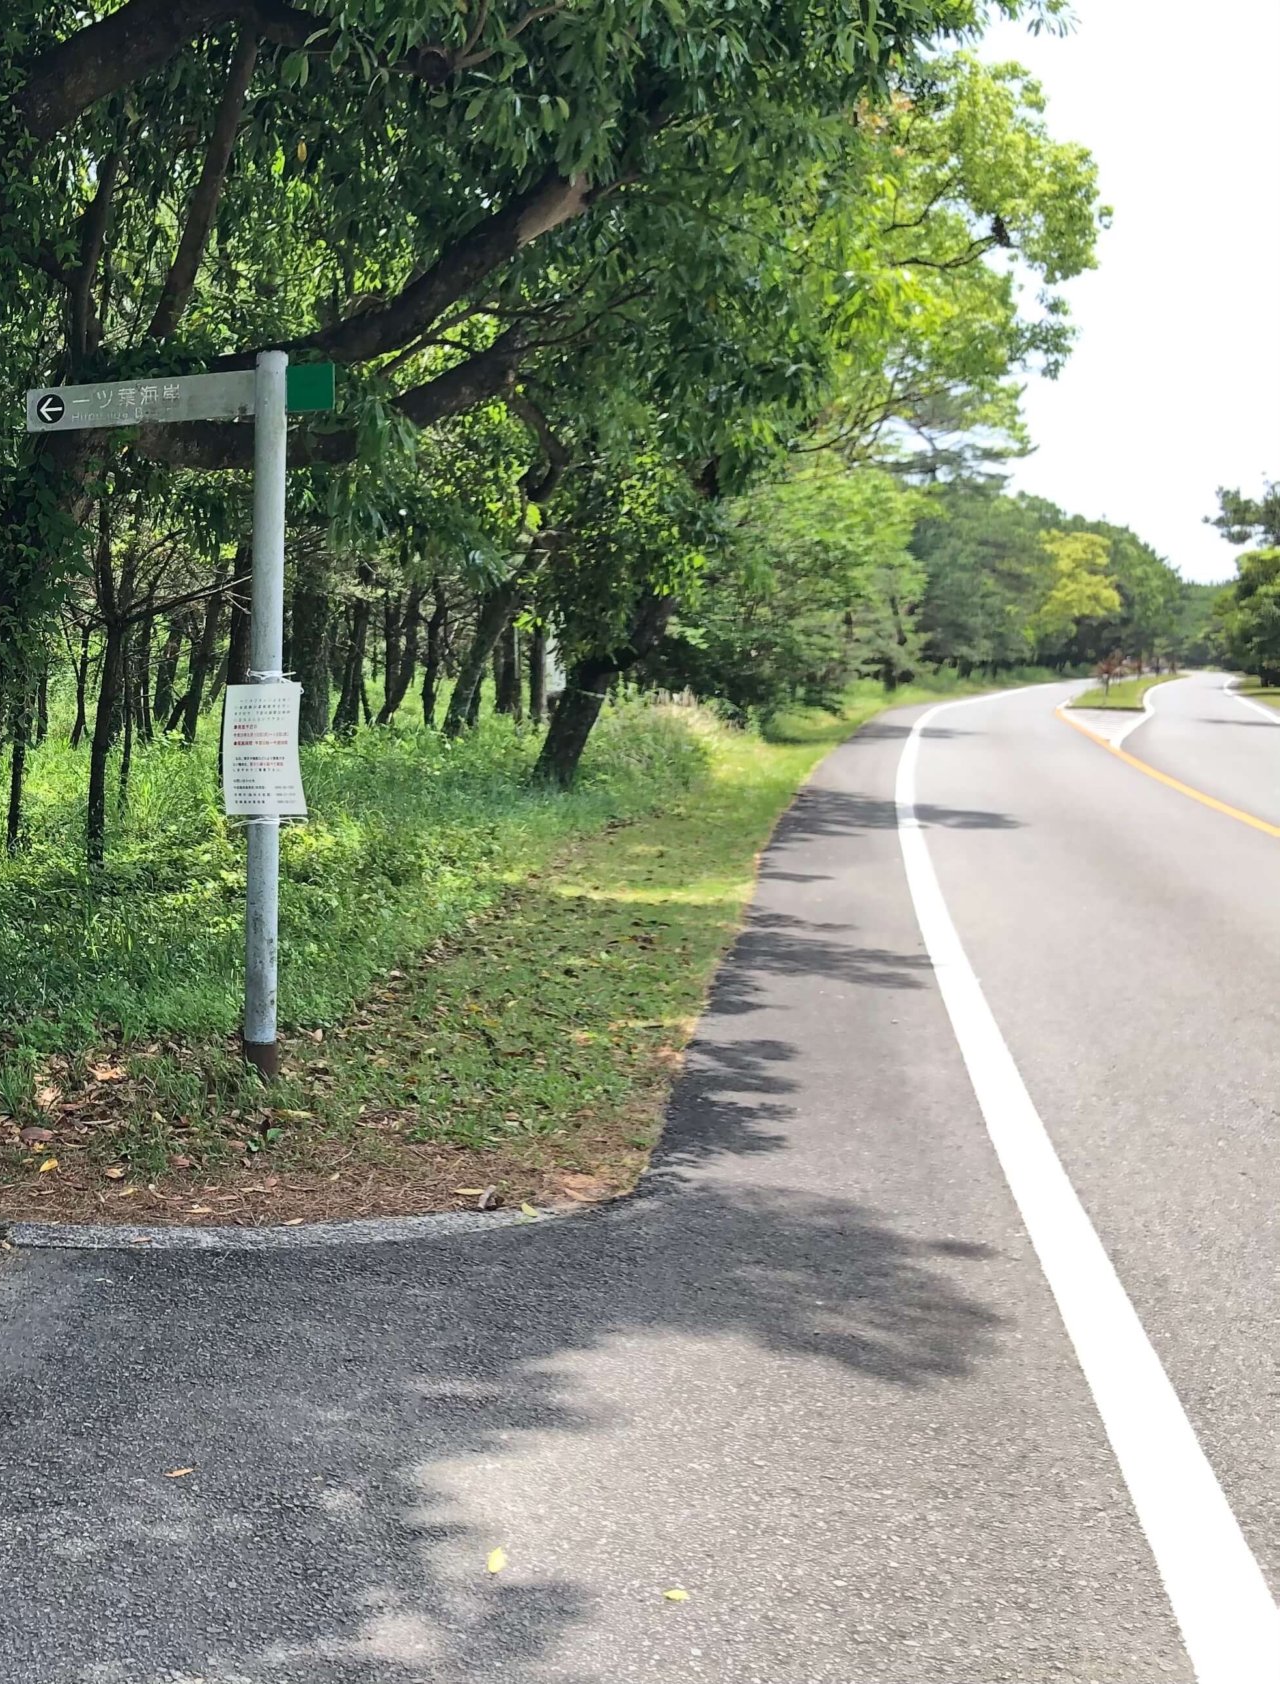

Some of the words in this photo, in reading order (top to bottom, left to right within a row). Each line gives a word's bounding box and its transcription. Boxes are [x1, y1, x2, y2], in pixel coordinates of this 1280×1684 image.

[72, 383, 180, 408] 一ツ葉海岸
